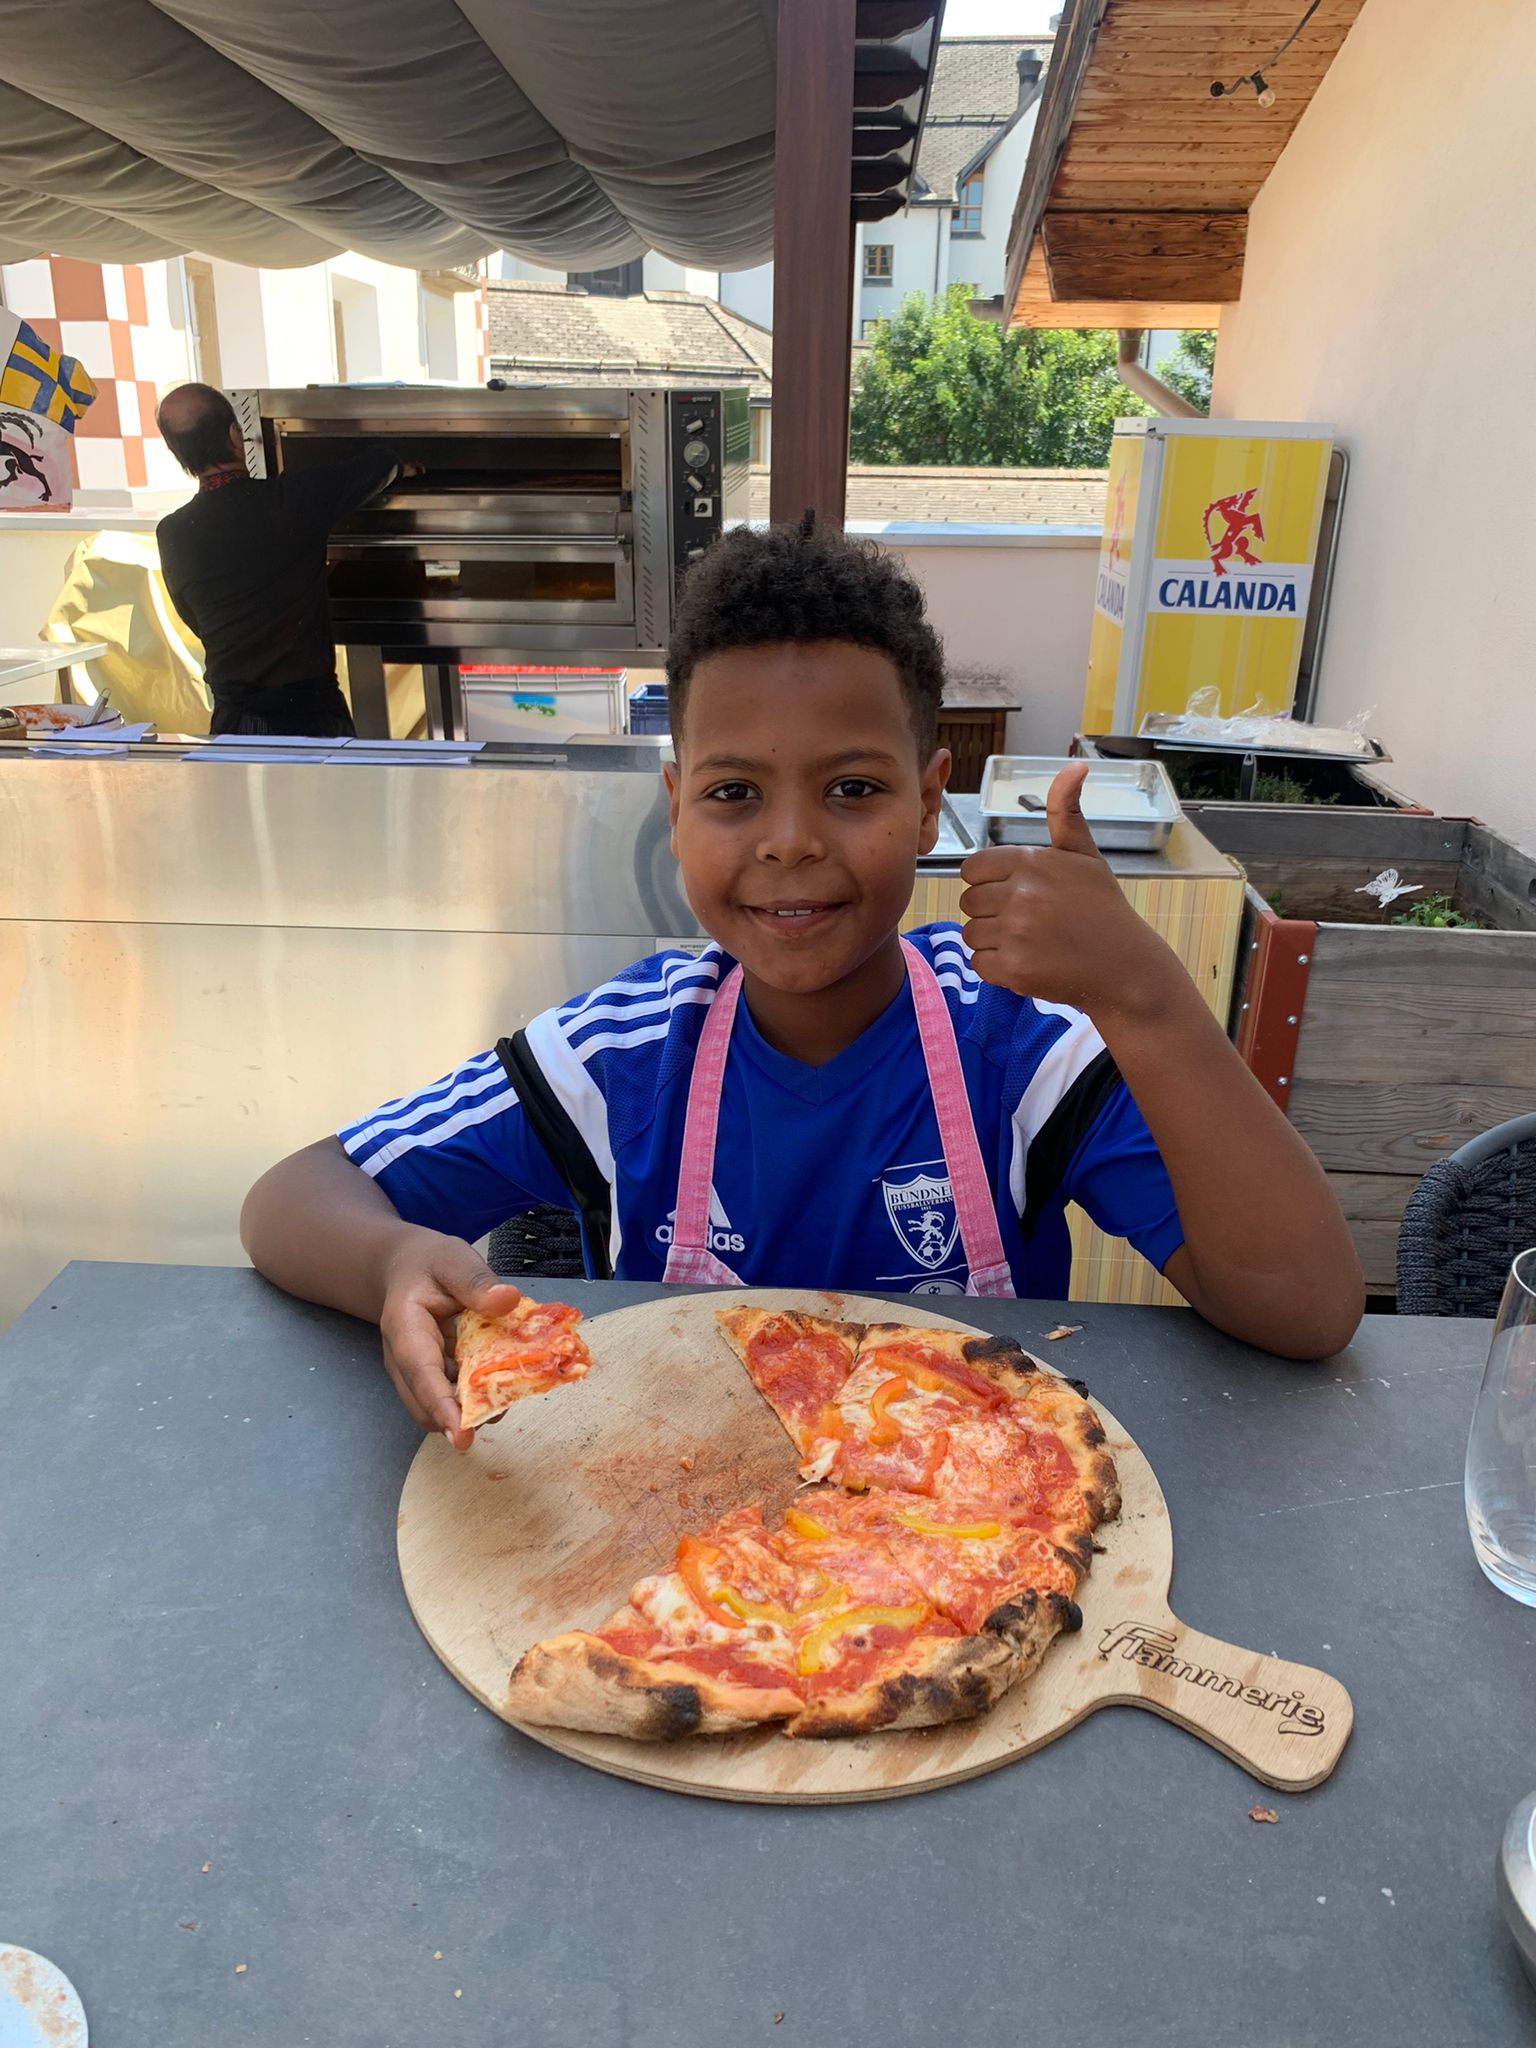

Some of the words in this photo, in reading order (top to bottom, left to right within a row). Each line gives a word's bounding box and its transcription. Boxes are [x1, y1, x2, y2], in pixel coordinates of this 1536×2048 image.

[1097, 573, 1125, 620] CALANDA
[1158, 578, 1296, 612] CALANDA
[893, 1196, 953, 1212] FUSSBALLVERBAN
[655, 1224, 746, 1252] aas
